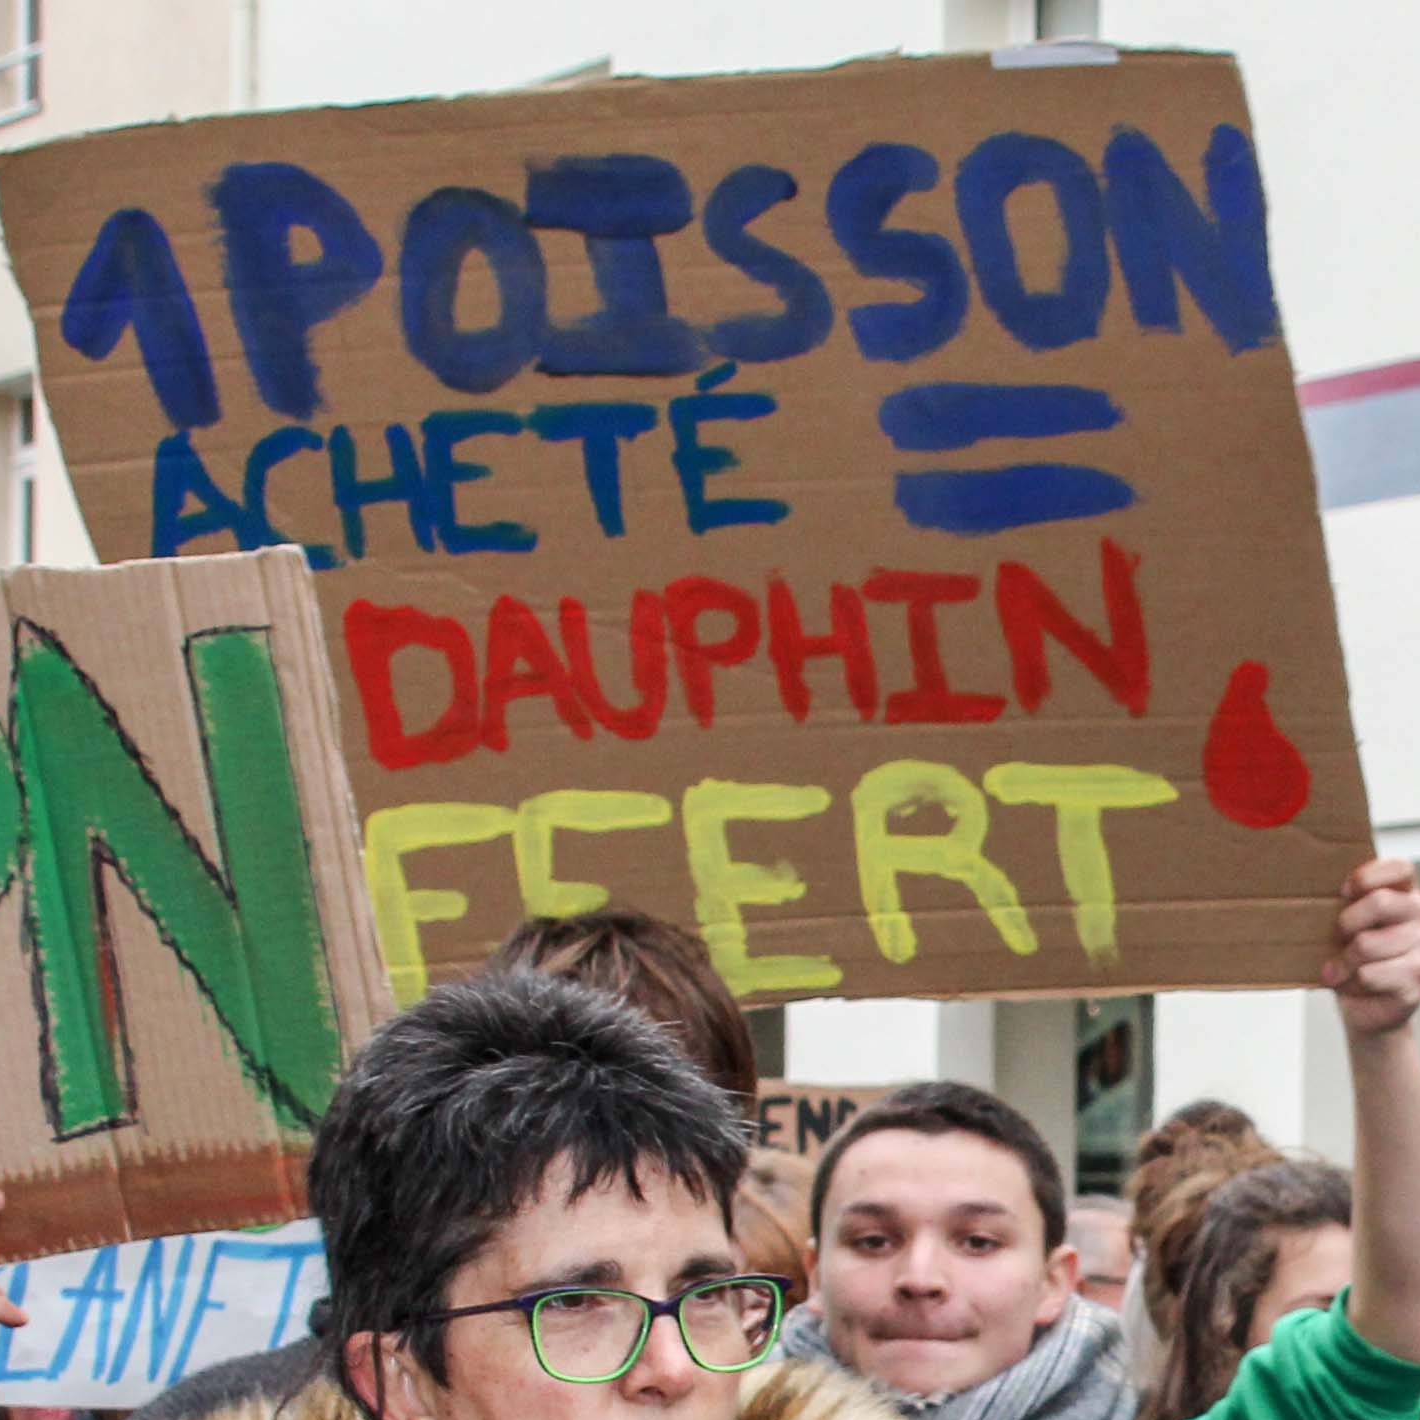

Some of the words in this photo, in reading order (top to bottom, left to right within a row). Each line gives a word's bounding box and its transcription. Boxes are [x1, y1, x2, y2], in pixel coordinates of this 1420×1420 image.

[61, 208, 223, 427] 1
[201, 123, 1281, 420] POISSON
[151, 362, 788, 570] ACHETÉ
[343, 538, 1151, 770] DAUPHIN
[364, 761, 1178, 999] FFERT
